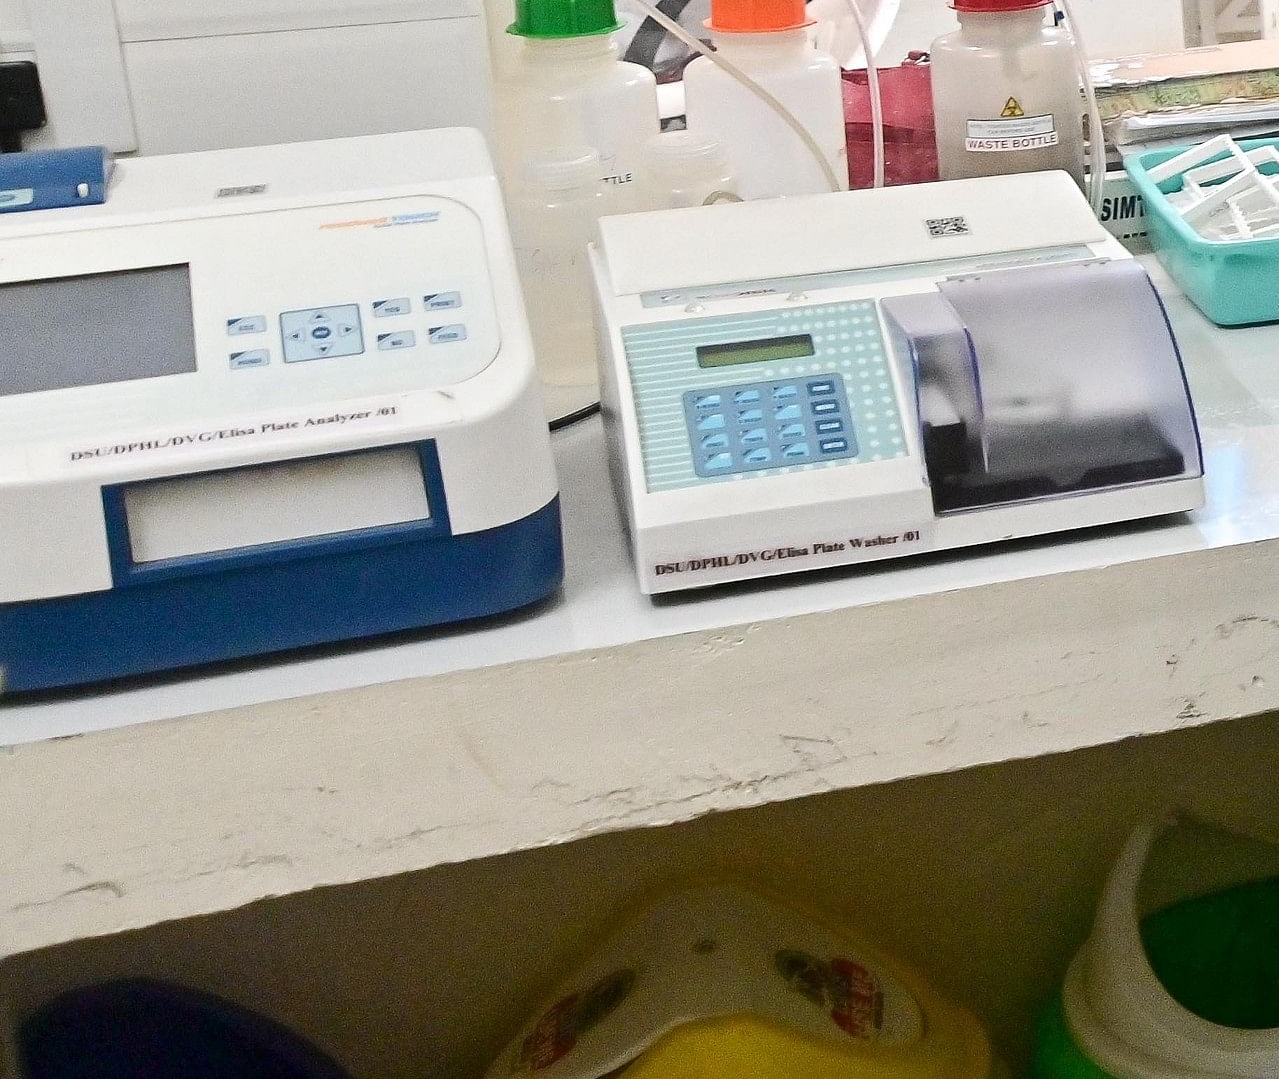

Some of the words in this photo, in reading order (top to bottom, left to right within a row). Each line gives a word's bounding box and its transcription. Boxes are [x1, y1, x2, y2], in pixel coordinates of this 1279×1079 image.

[967, 138, 1010, 150] WASTE
[1012, 134, 1057, 149] BOTTLE
[1100, 194, 1146, 222] SIMT
[262, 418, 299, 434] Plate
[303, 407, 371, 428] Analyzer
[813, 541, 845, 556] Plate
[849, 534, 899, 548] Washer
